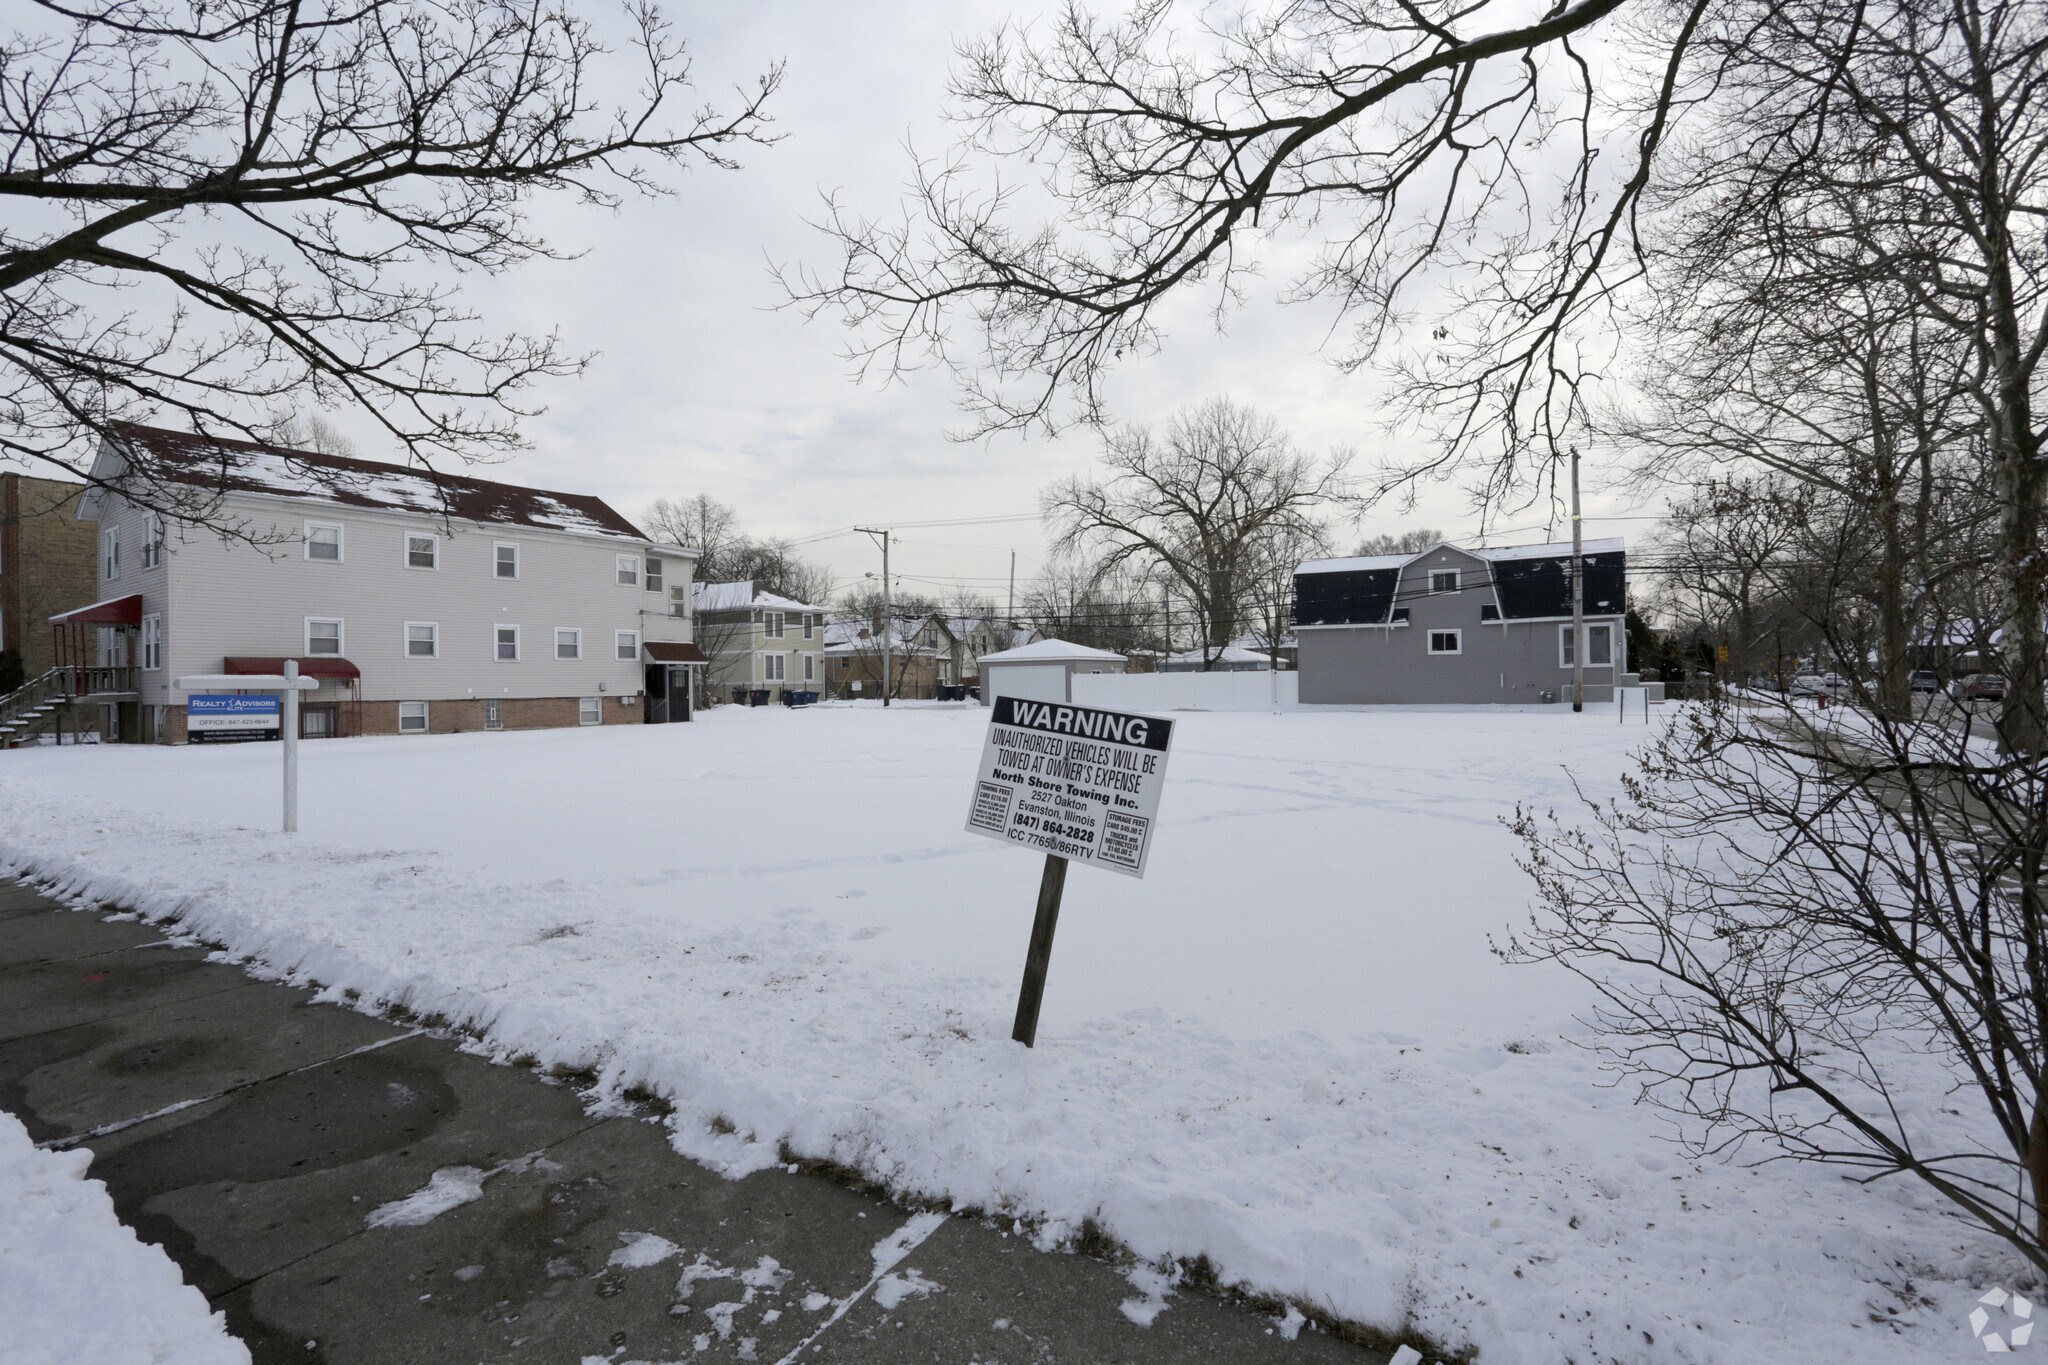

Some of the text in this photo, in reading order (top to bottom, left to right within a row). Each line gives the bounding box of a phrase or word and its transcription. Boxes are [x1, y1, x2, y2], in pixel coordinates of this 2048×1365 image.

[1013, 701, 1149, 745] WARNING
[992, 728, 1158, 775] UNAUTHORIZED VEHICLES WILL BE
[998, 748, 1142, 794] TOWED AT OWNER'S EXPENSE
[992, 768, 1139, 809] North Shore Towing Inc.
[1031, 790, 1087, 811] 2527 Oakton
[1018, 799, 1061, 820] Evanston,
[1064, 810, 1095, 827] Illinois
[1108, 813, 1146, 828] STORAGE FEES
[1007, 828, 1025, 841] ICC
[1013, 812, 1040, 830] (847)
[1042, 820, 1095, 843] 864-2828
[1106, 821, 1120, 830] CARS
[1120, 824, 1138, 834] $45.00
[1110, 831, 1128, 841] TRUCKS
[1105, 837, 1139, 851] MOTORCYCLES
